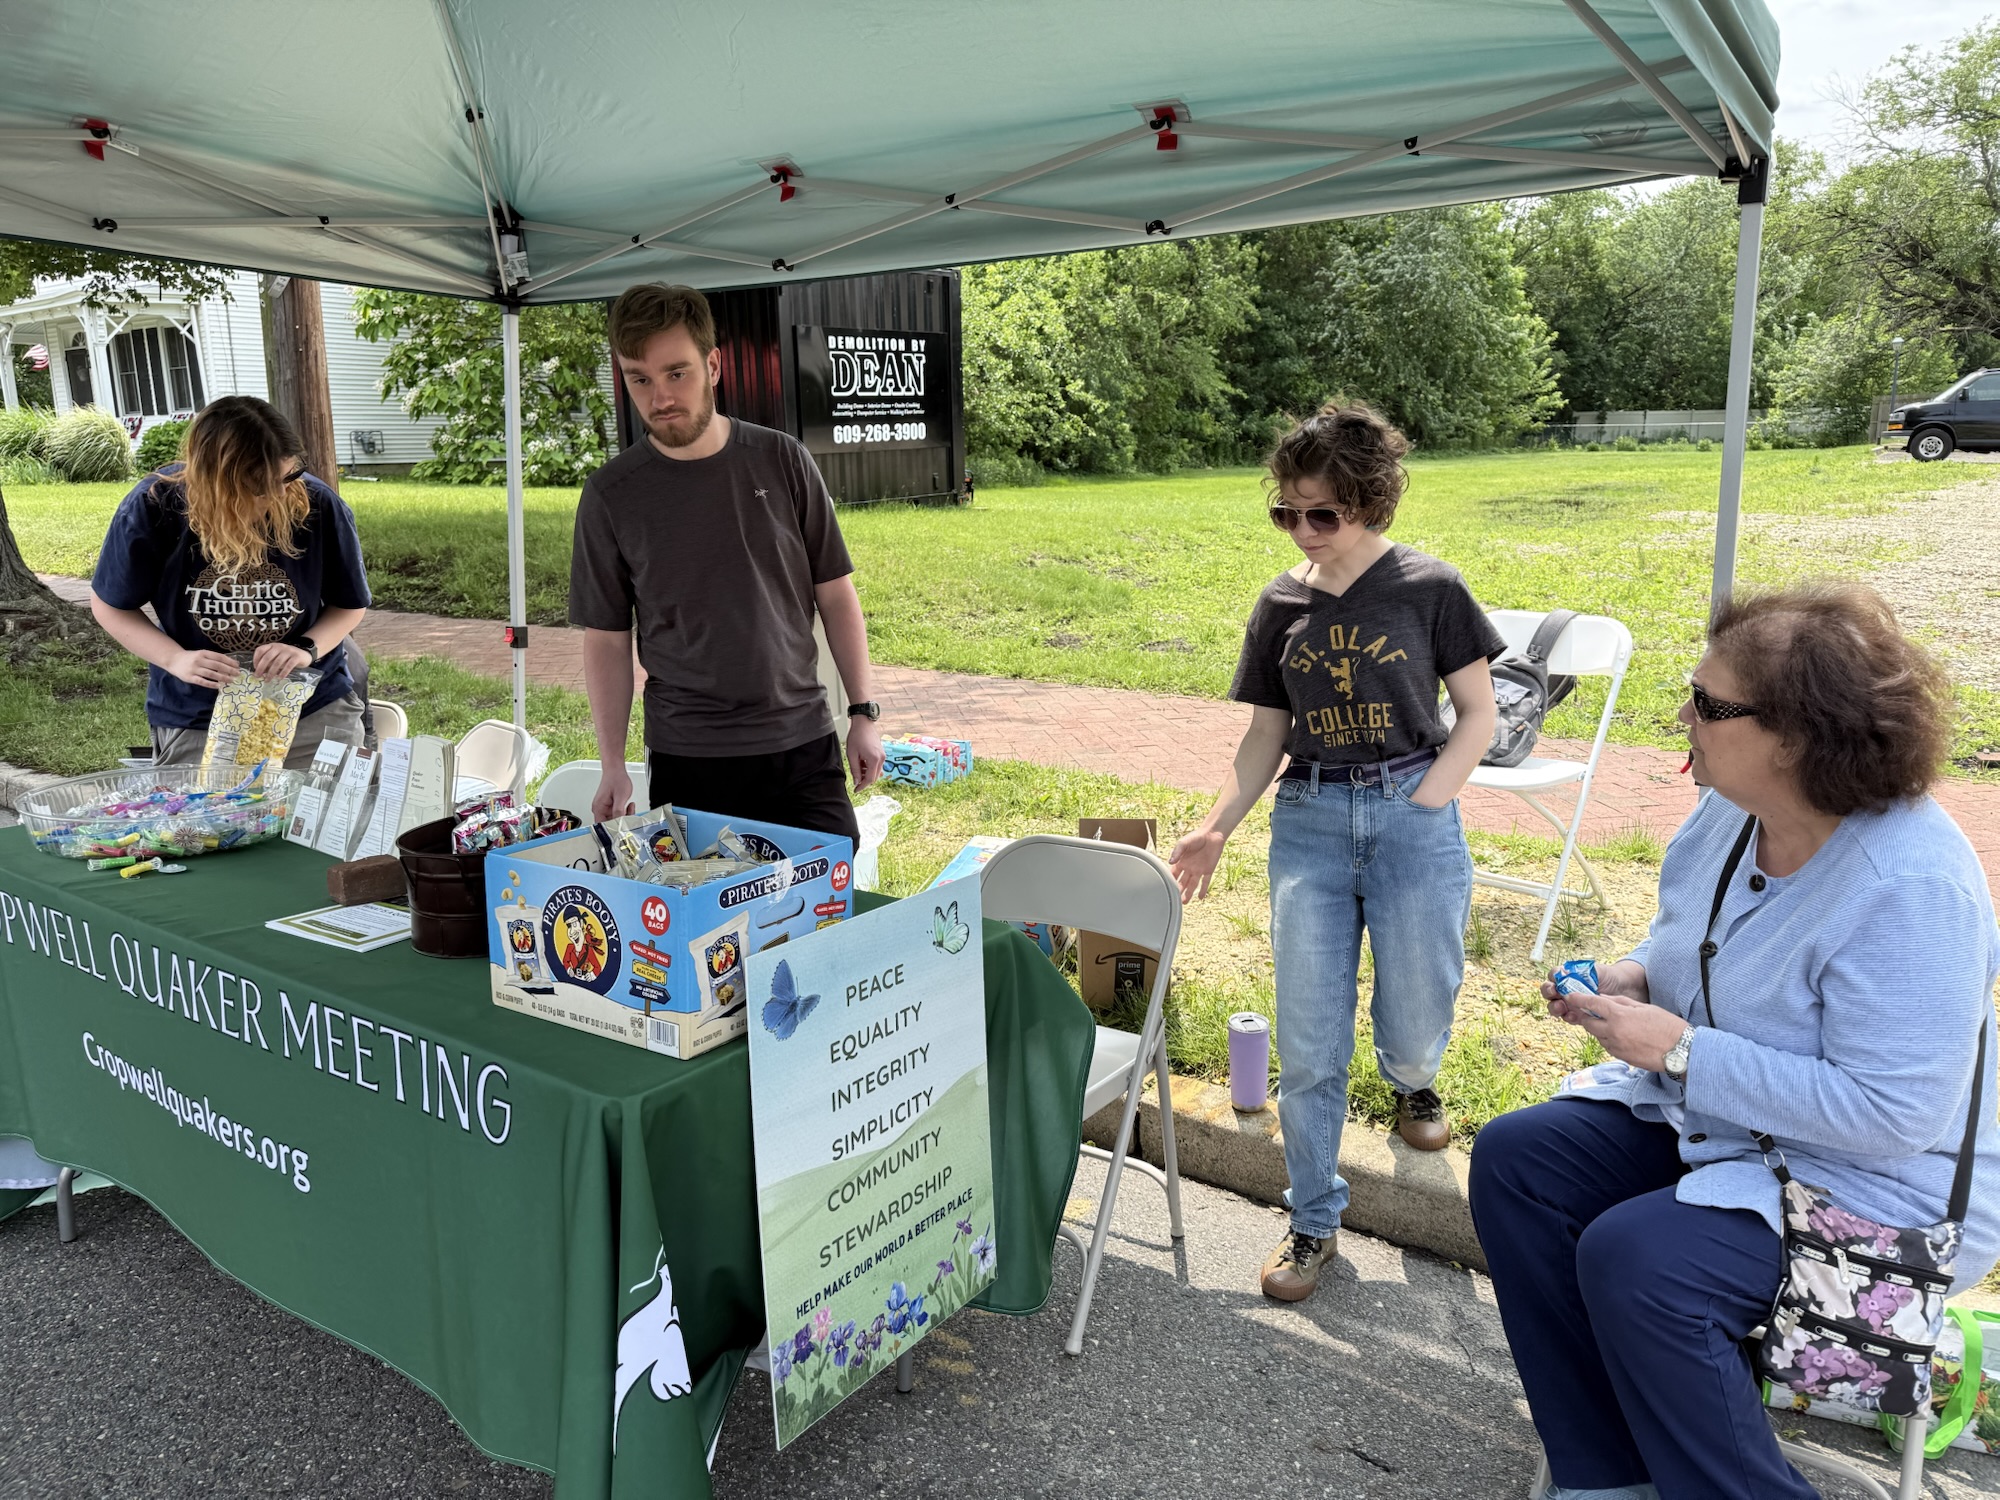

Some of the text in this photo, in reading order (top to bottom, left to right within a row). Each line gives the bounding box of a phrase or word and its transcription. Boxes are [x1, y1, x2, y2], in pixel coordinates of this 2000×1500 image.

[828, 335, 926, 352] DEMOLITION BY
[829, 351, 926, 396] DEAN
[833, 422, 927, 444] 609-268-3900
[199, 615, 294, 632] ODYSSEY
[1289, 624, 1409, 673] ST. OLAF
[1306, 703, 1394, 735] COLLEGE
[1323, 730, 1362, 747] SINCE
[833, 863, 849, 880] 40
[543, 888, 619, 941] PIRATE'S BOOTY
[644, 902, 667, 922] 40
[648, 920, 664, 930] BAGS
[846, 964, 904, 1007] PEACE
[1118, 961, 1141, 970] prime
[0, 889, 513, 1146] PWELL QUAKER MEETING
[830, 1001, 922, 1064] EQUALITY
[831, 1043, 930, 1113] INTEGRITY
[82, 1031, 312, 1194] Cropwellquakers.org
[832, 1086, 934, 1161] SIMPLICITY
[827, 1126, 942, 1212] COMMUNITY
[820, 1165, 952, 1268] STEWARDSHIP
[796, 1187, 973, 1320] HELP MAKE OUR WORLD A BETTER PLACE
